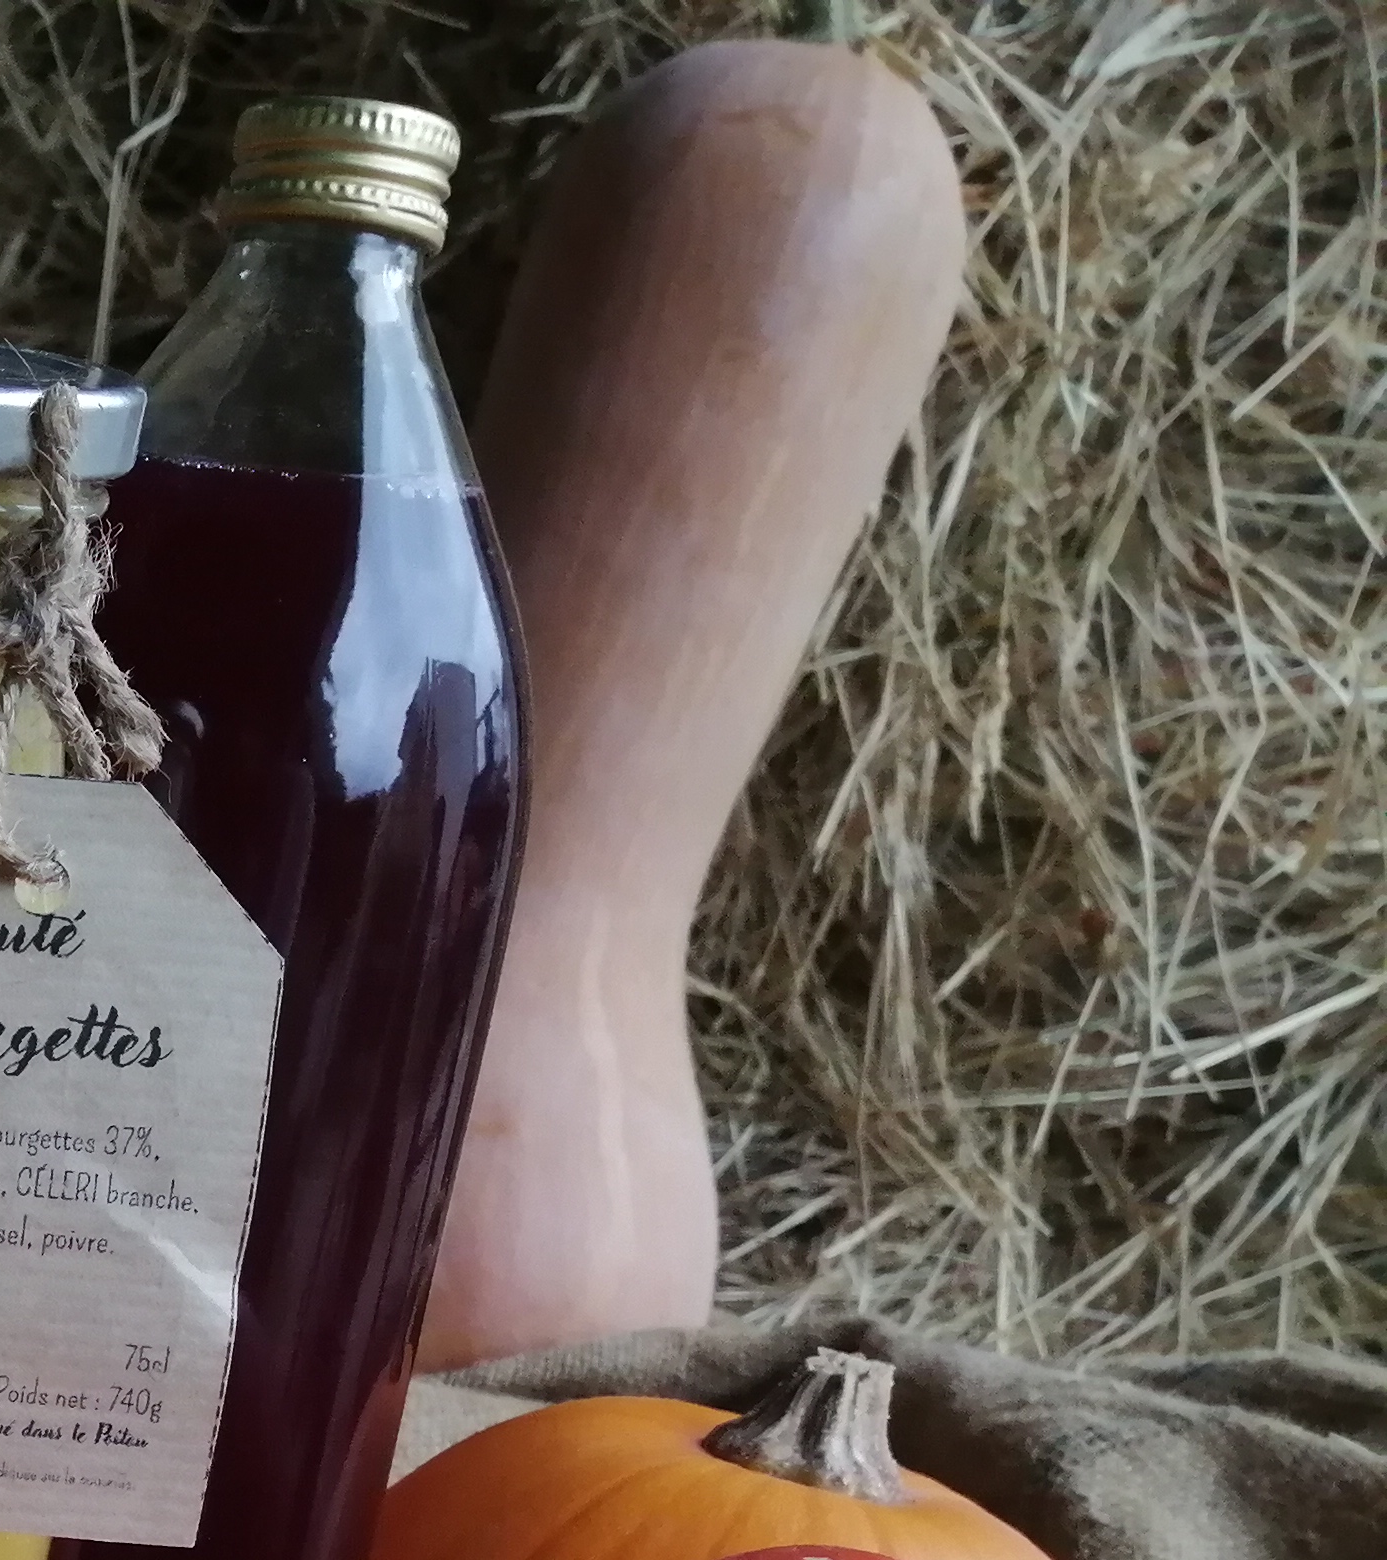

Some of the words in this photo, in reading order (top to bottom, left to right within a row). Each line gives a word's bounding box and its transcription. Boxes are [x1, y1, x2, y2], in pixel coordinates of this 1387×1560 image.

[16, 1163, 99, 1203] CÉLERI
[41, 1229, 115, 1257] poivre.
[55, 1392, 88, 1410] net
[109, 1385, 163, 1424] 740g
[21, 1419, 63, 1441] dans
[71, 1422, 88, 1444] le
